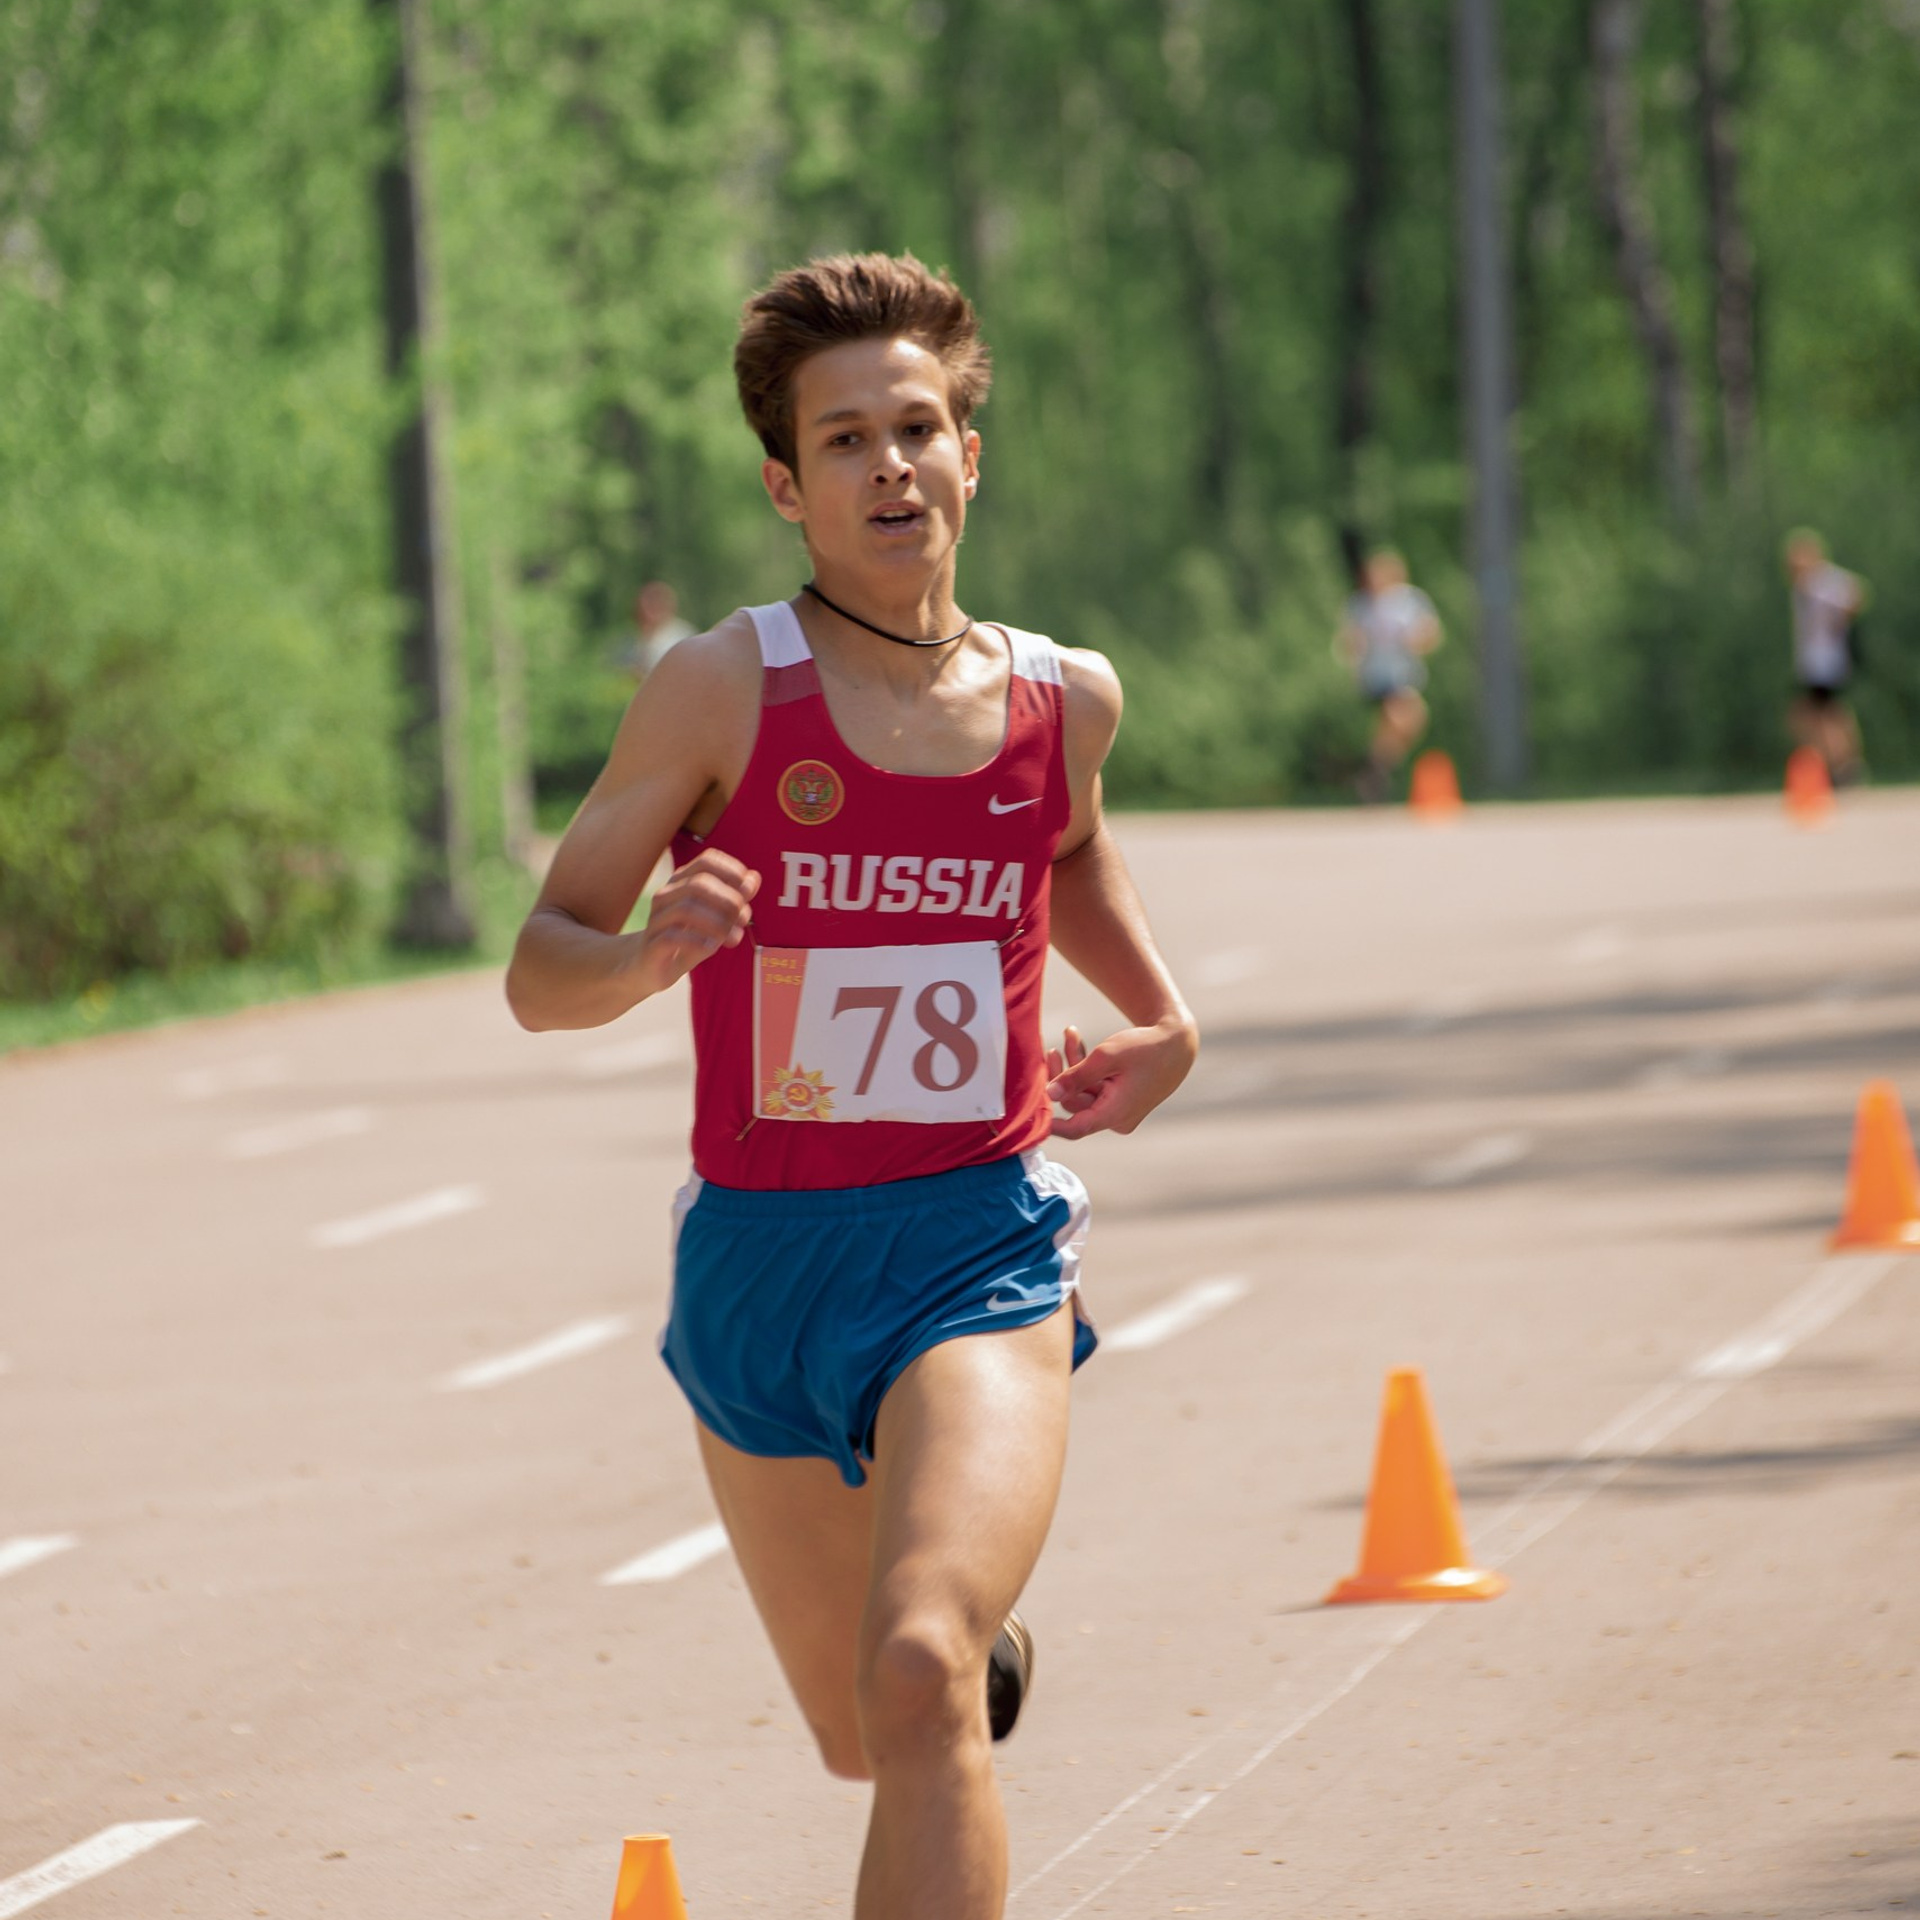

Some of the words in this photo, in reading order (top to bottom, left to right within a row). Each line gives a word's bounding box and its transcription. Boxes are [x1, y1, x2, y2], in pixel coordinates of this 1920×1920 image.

[778, 851, 1025, 919] RUSSIA
[761, 956, 797, 969] 1941
[765, 973, 803, 986] 1945
[830, 980, 979, 1096] 78
